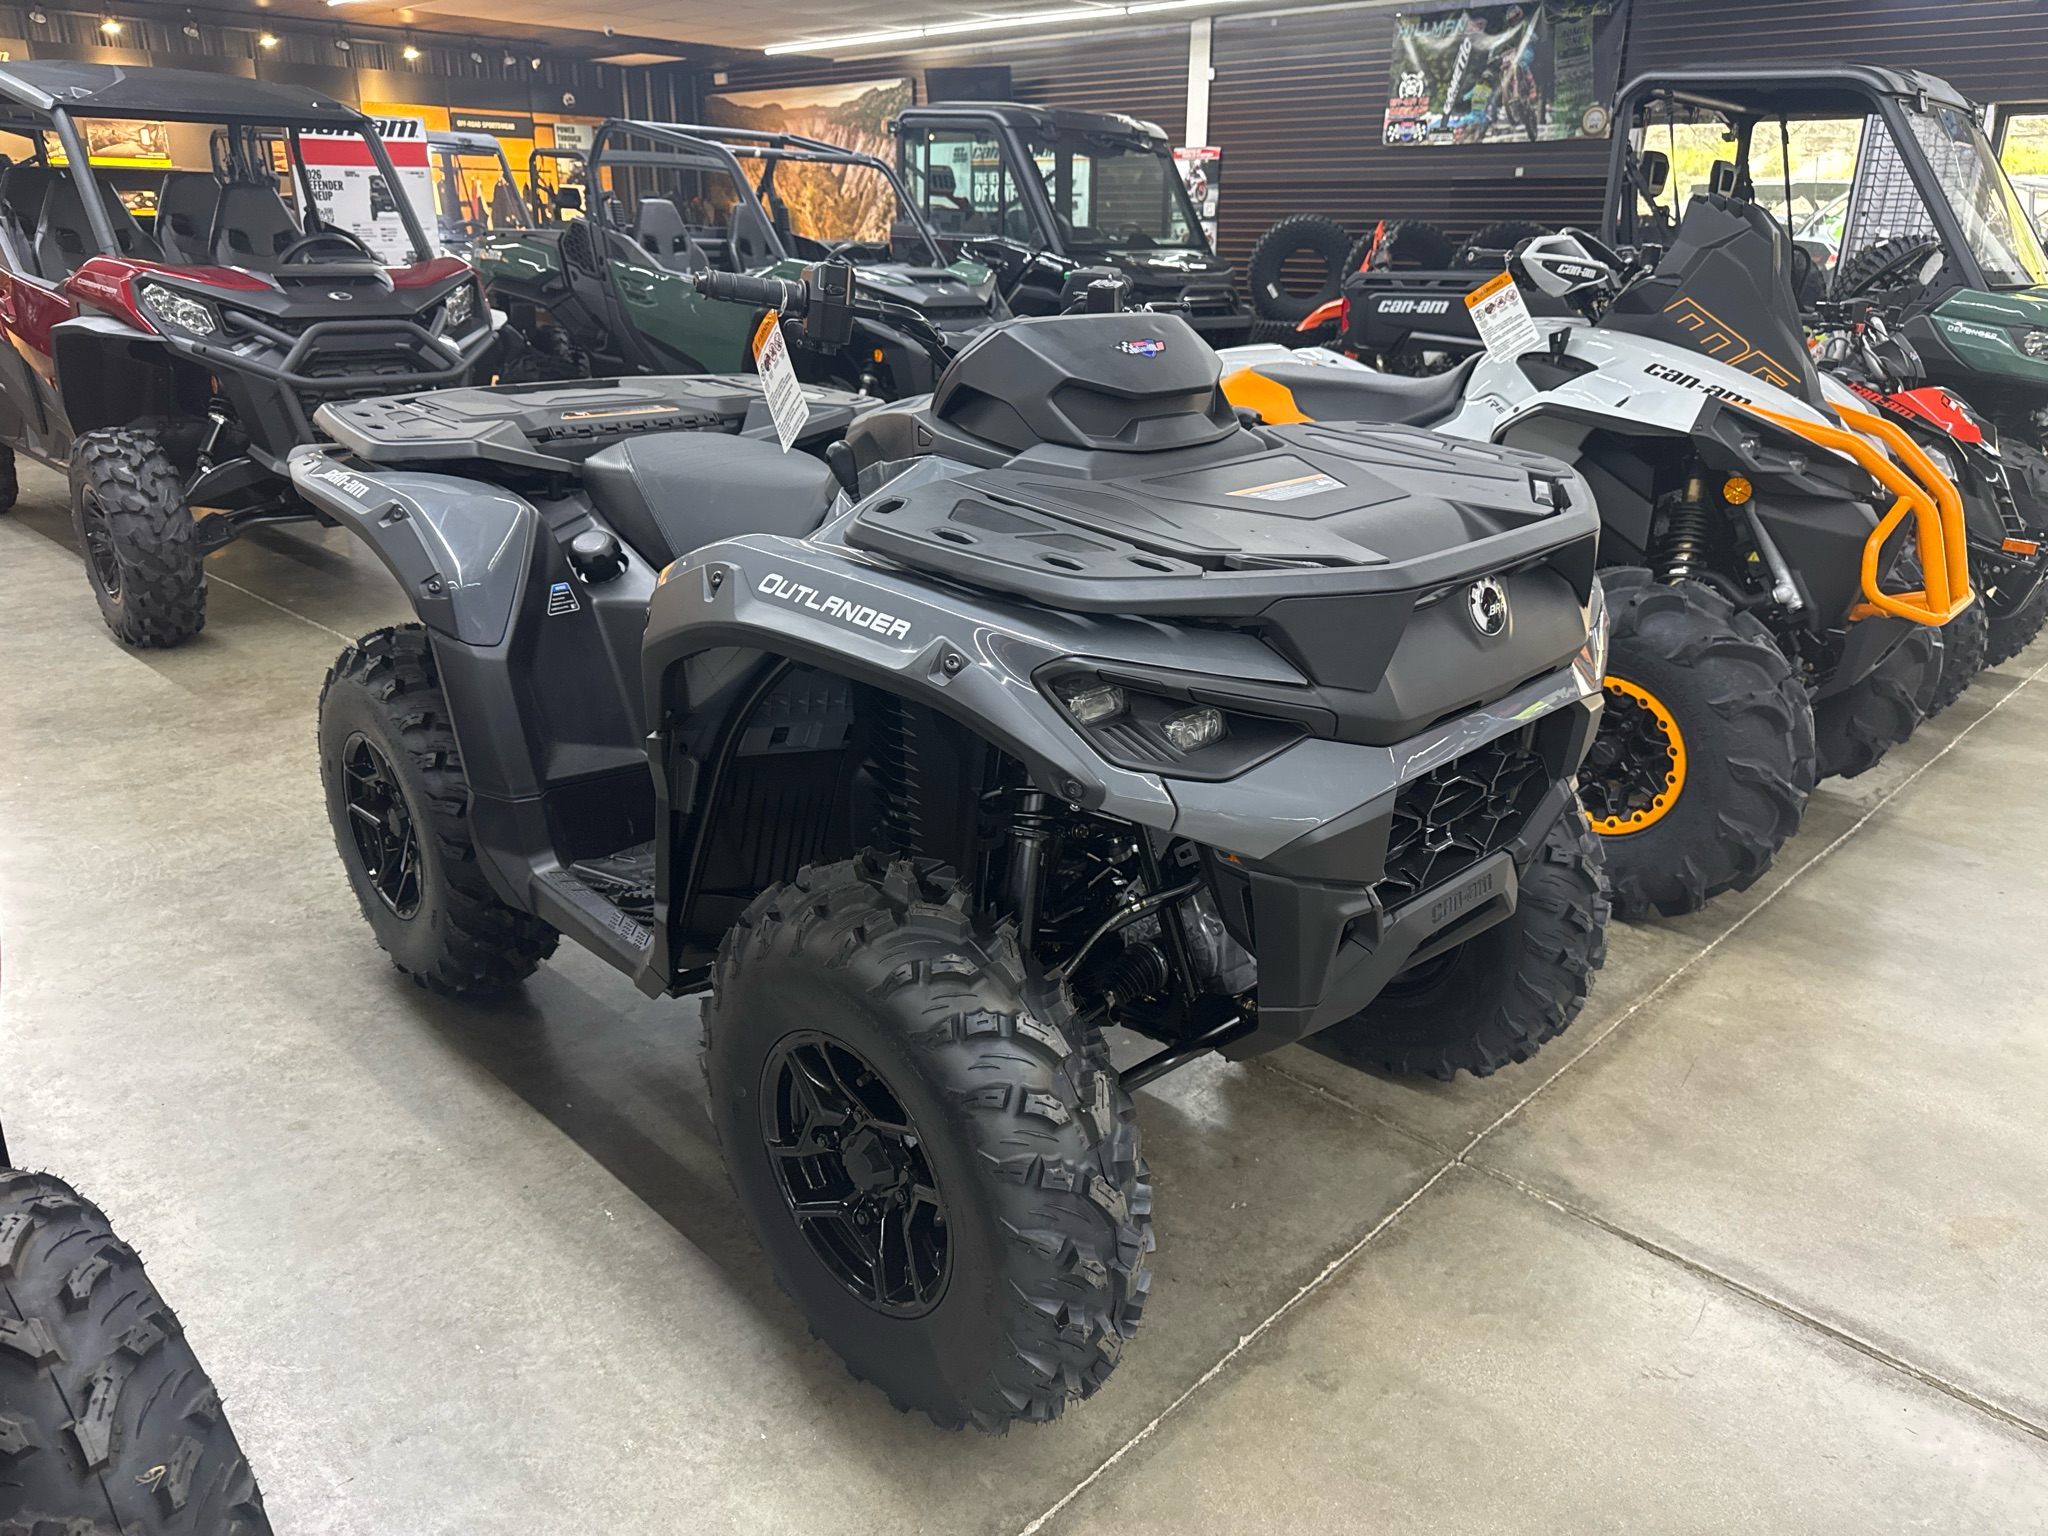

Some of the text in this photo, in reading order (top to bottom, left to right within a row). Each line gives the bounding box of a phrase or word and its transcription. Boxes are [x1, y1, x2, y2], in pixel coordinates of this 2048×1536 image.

[306, 170, 322, 180] 026
[309, 180, 344, 191] EFENDER
[1556, 262, 1597, 280] can-am
[1377, 299, 1450, 314] can-am
[1947, 325, 1998, 341] DEFENDER
[1643, 363, 1754, 407] can-am
[1848, 382, 1917, 420] can-am
[323, 469, 370, 499] can-am
[758, 573, 912, 640] OUTLANDER
